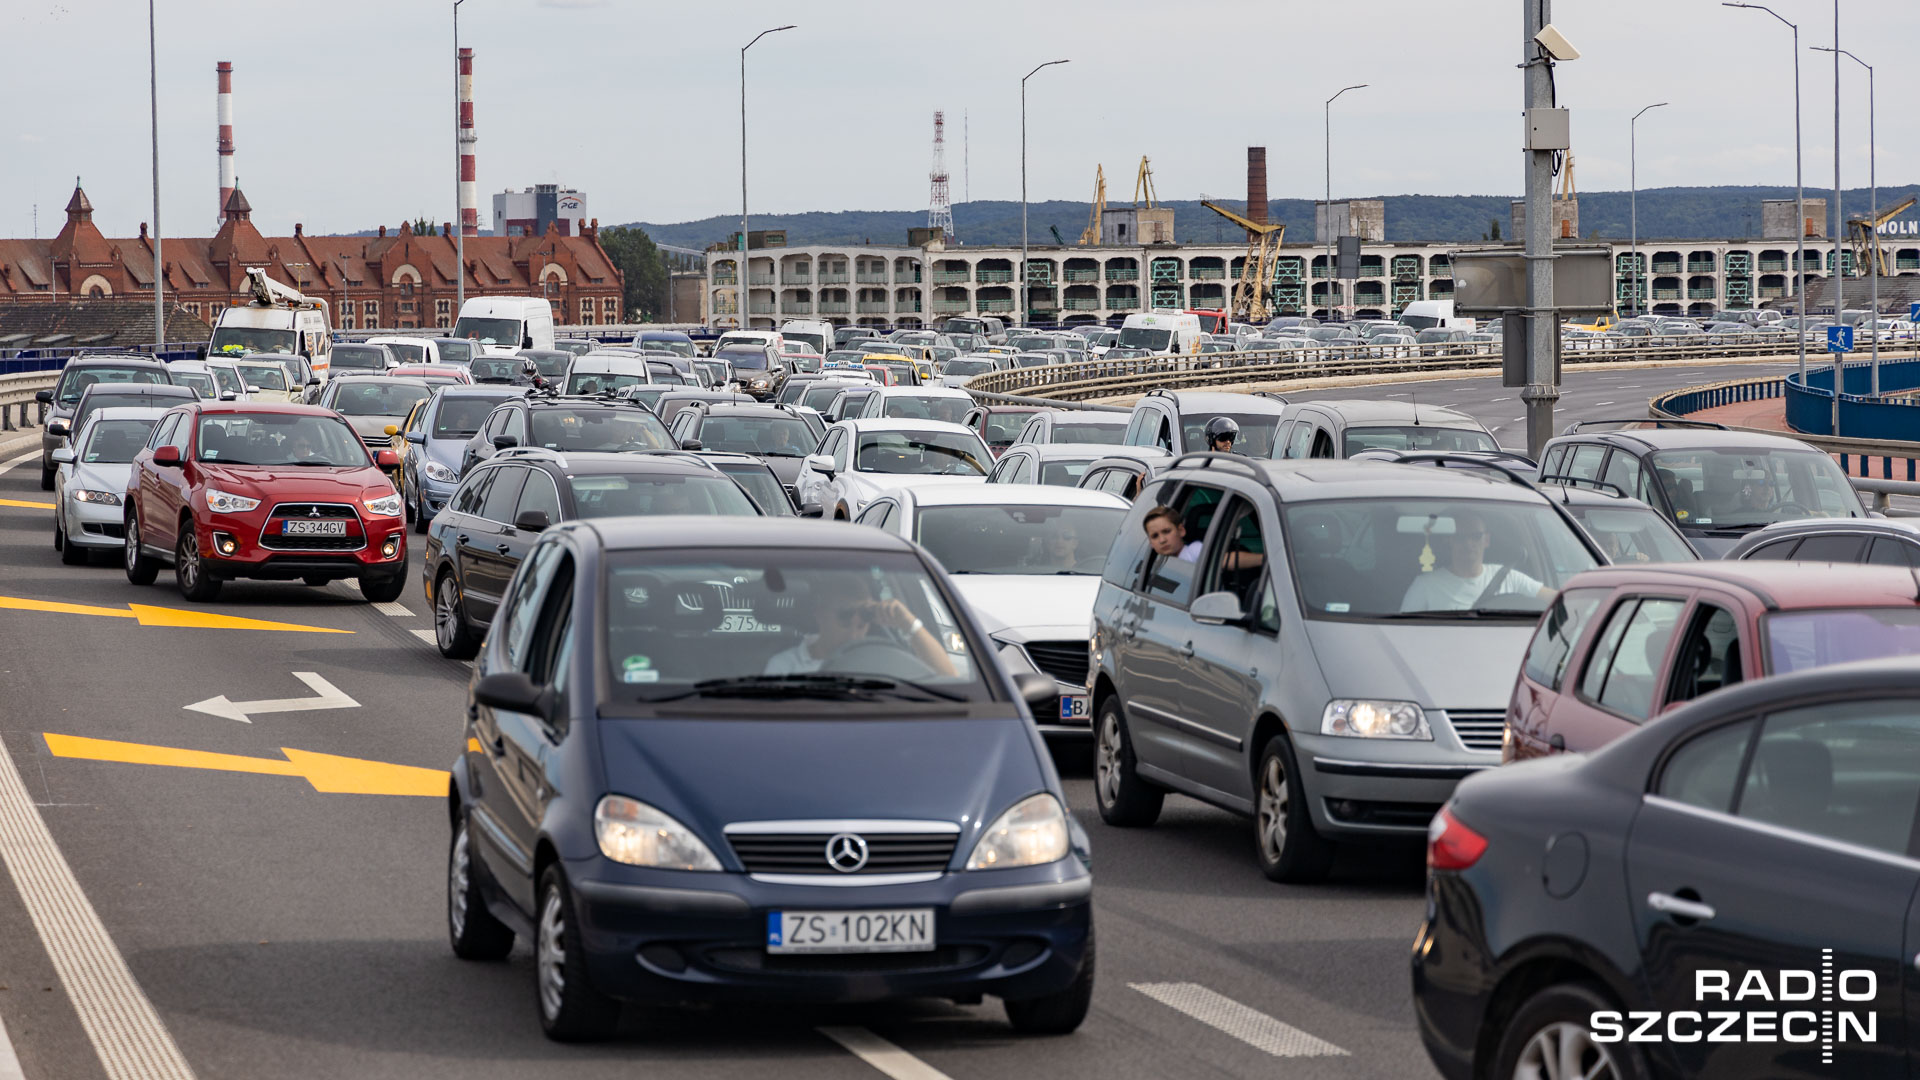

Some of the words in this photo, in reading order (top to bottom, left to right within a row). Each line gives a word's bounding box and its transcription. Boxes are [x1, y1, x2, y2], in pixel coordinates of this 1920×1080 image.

[1876, 220, 1920, 234] WOLN
[289, 522, 306, 533] ZS
[309, 522, 344, 533] 344GV
[788, 915, 826, 944] ZS
[840, 913, 926, 943] 102KN
